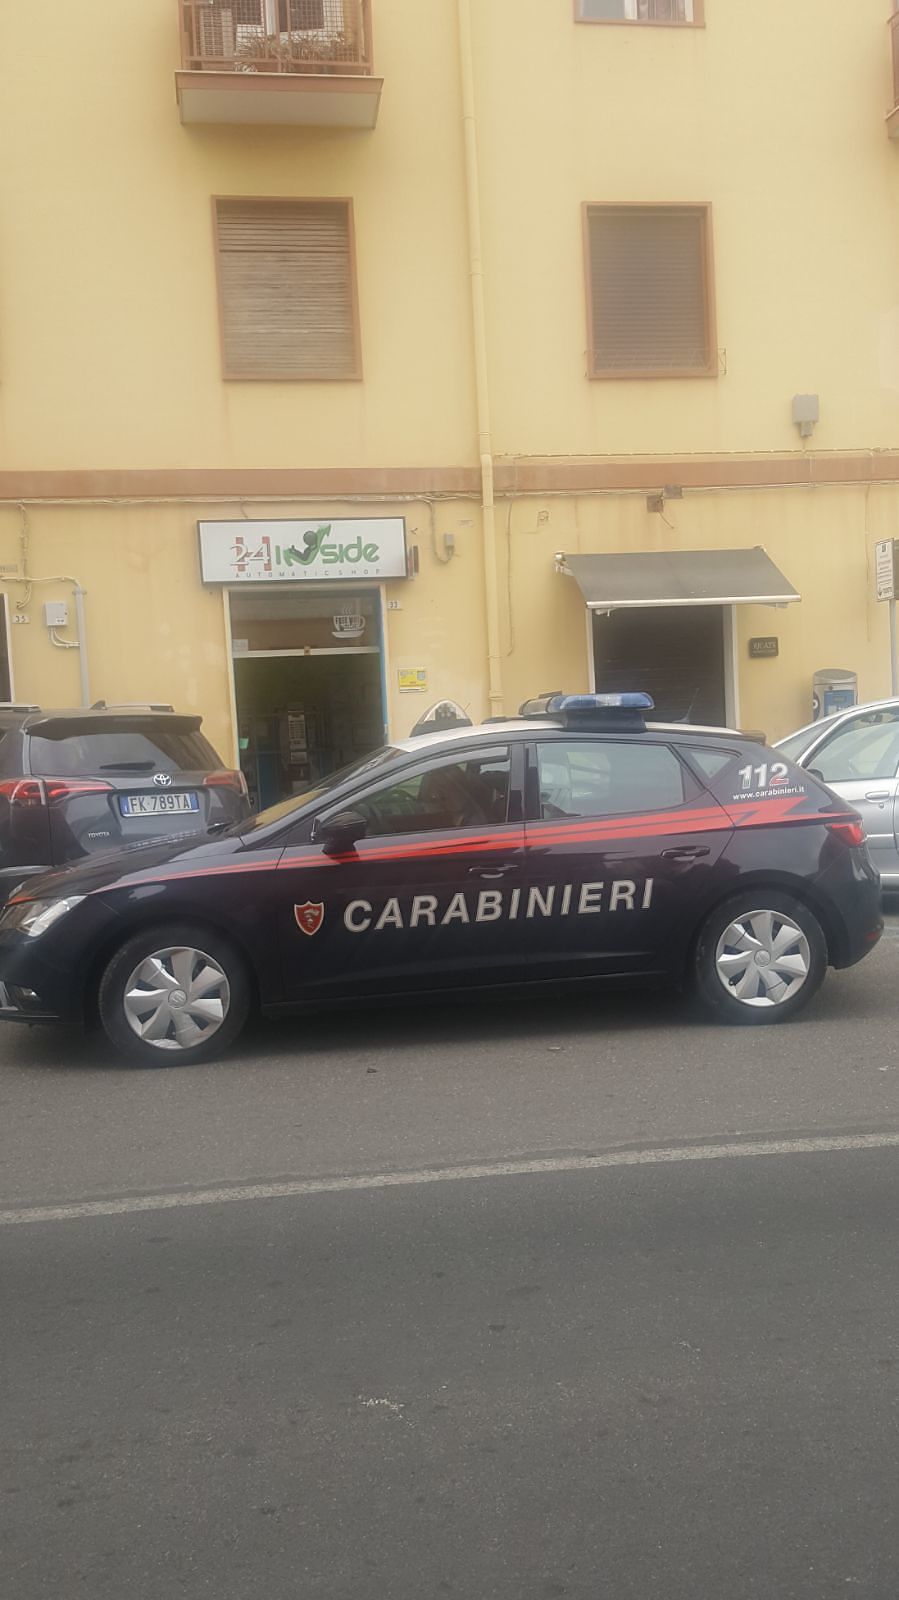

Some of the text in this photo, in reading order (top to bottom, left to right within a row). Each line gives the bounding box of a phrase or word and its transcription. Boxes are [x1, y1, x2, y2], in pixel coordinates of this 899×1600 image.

[738, 762, 789, 790] 112
[129, 795, 191, 812] FK 789TA
[733, 785, 805, 800] www.carabinieri.it
[343, 878, 654, 932] CARABINIERI
